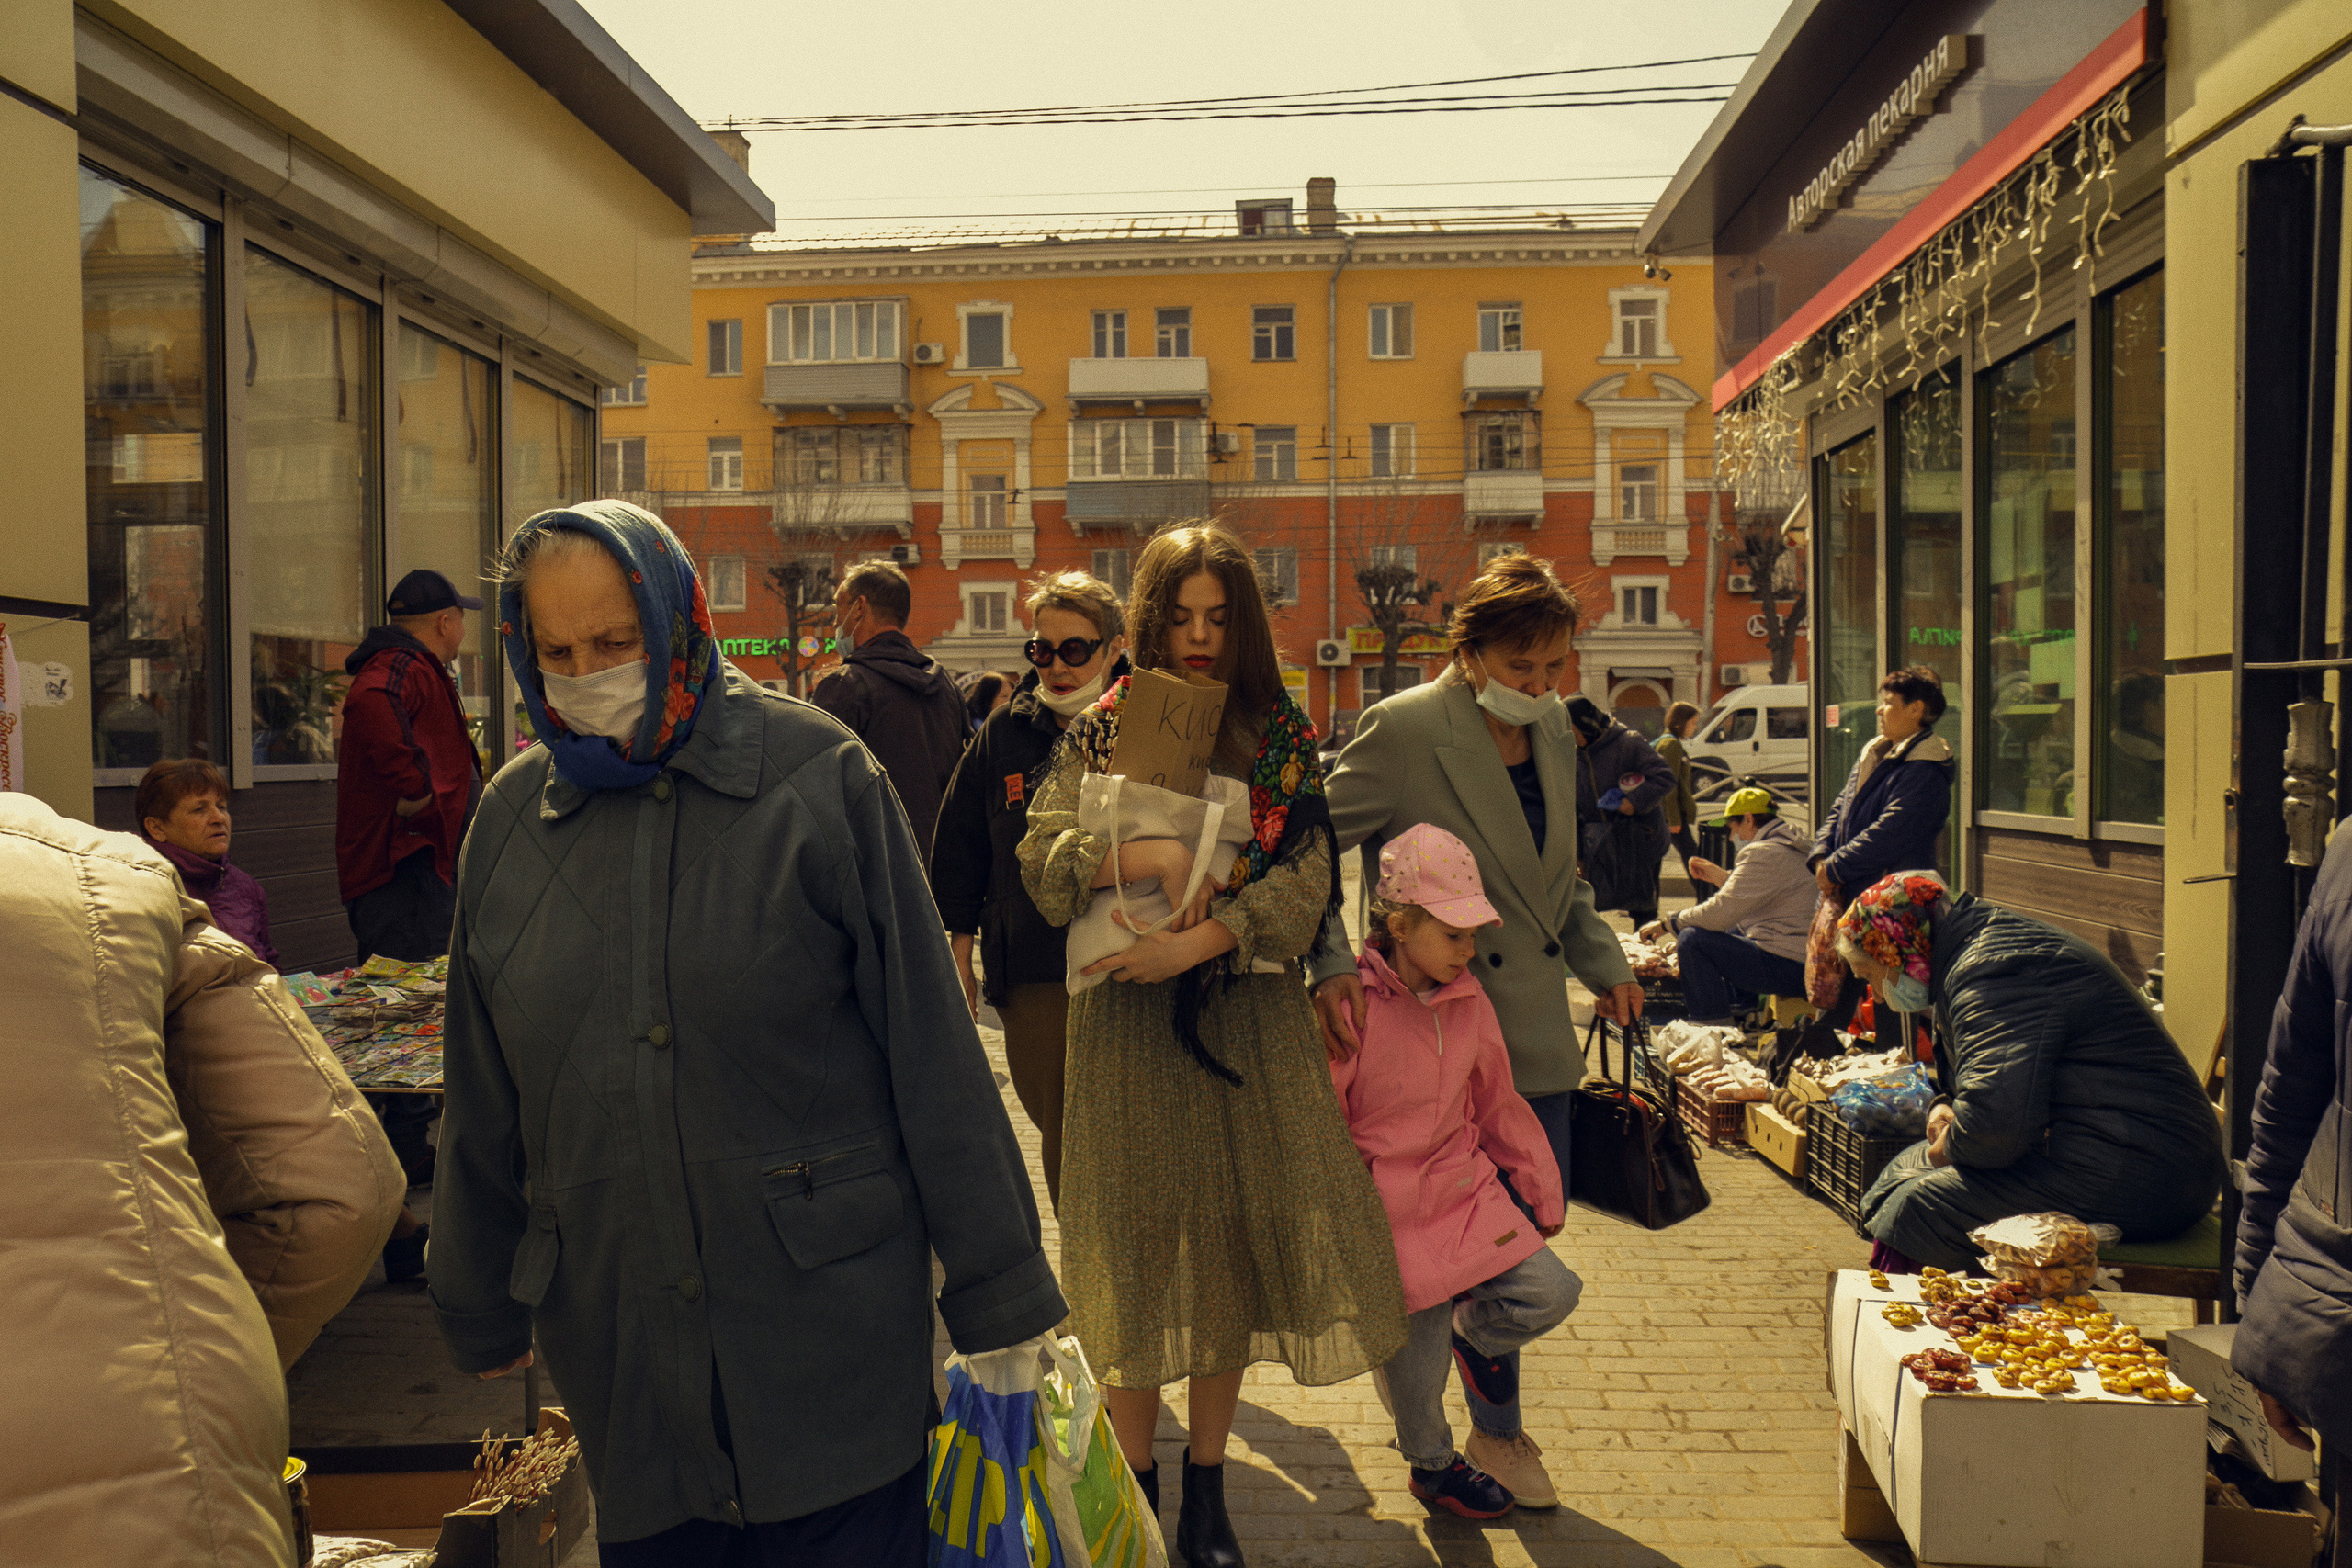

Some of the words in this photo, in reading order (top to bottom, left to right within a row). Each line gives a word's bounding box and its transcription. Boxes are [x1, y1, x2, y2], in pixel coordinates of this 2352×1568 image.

[1788, 127, 1866, 233] Авторская
[1868, 35, 1950, 150] пекарня
[717, 638, 790, 655] ПТЕКА
